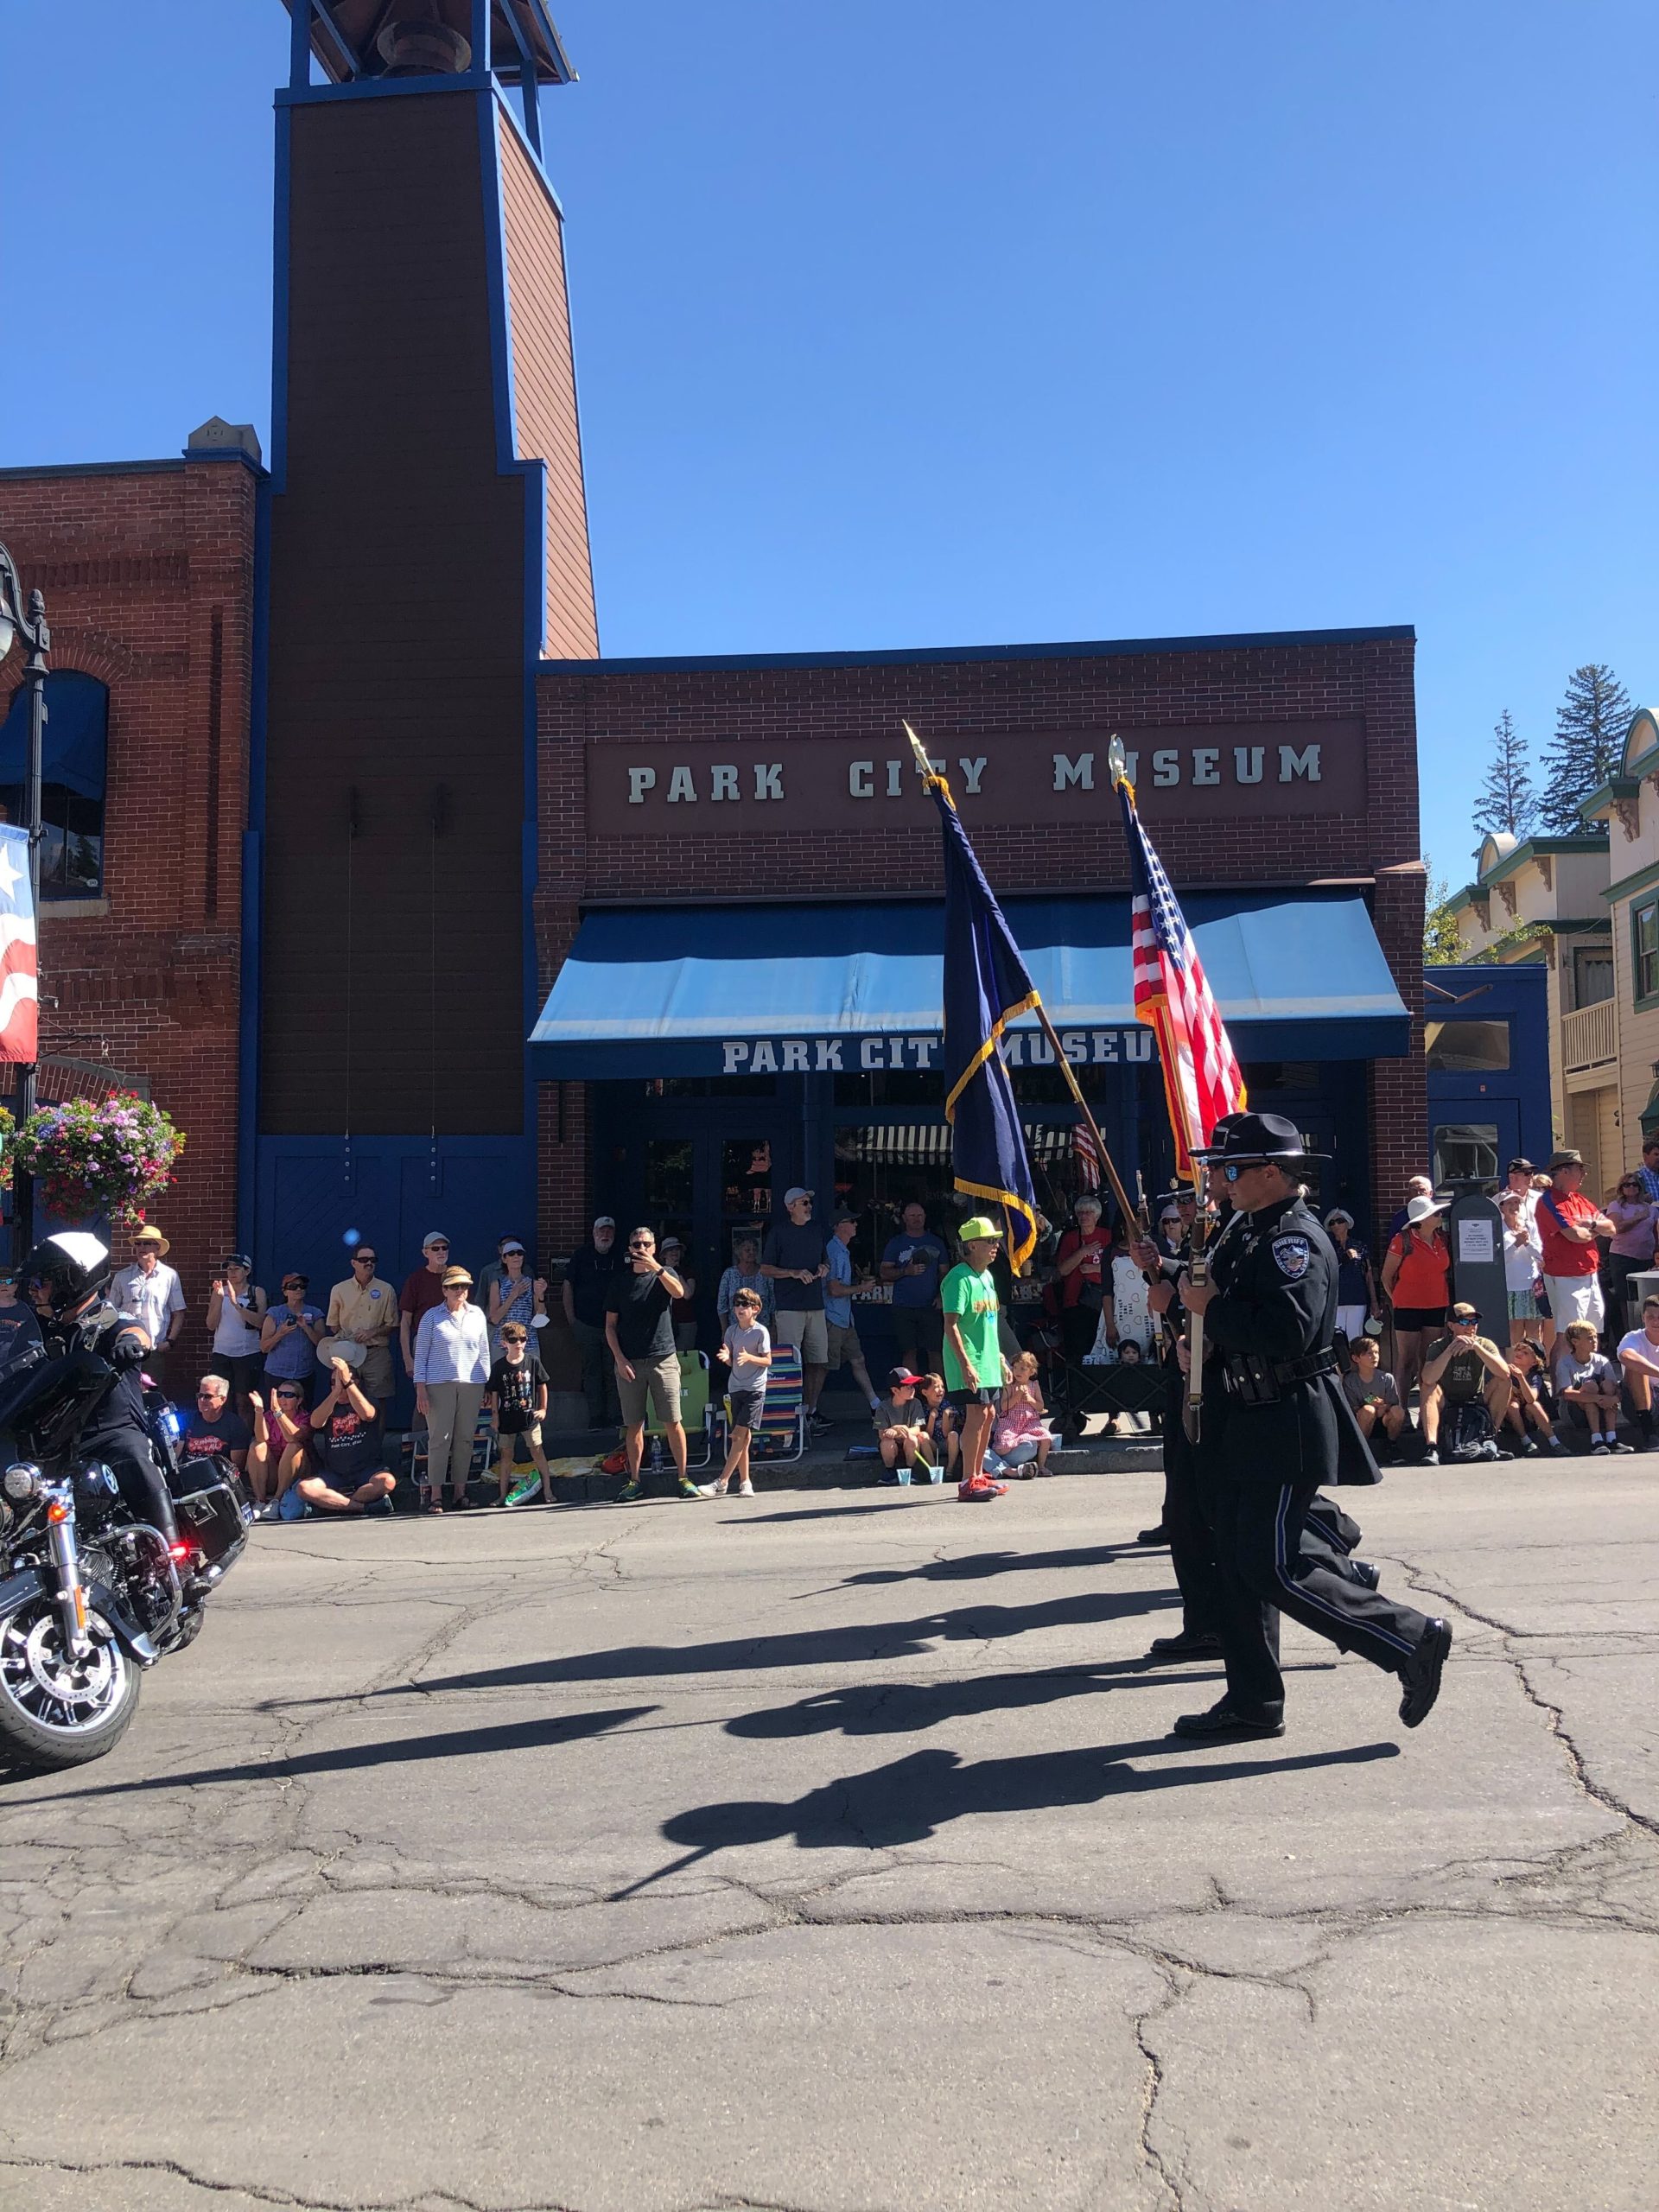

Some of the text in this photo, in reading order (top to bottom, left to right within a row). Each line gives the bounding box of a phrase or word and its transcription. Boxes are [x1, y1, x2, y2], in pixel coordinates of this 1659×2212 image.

[628, 744, 1321, 804] PARK CITY MUSEUM
[722, 1030, 1161, 1073] PARK CIT MUSEU
[1274, 1238, 1306, 1249] SHERIFF
